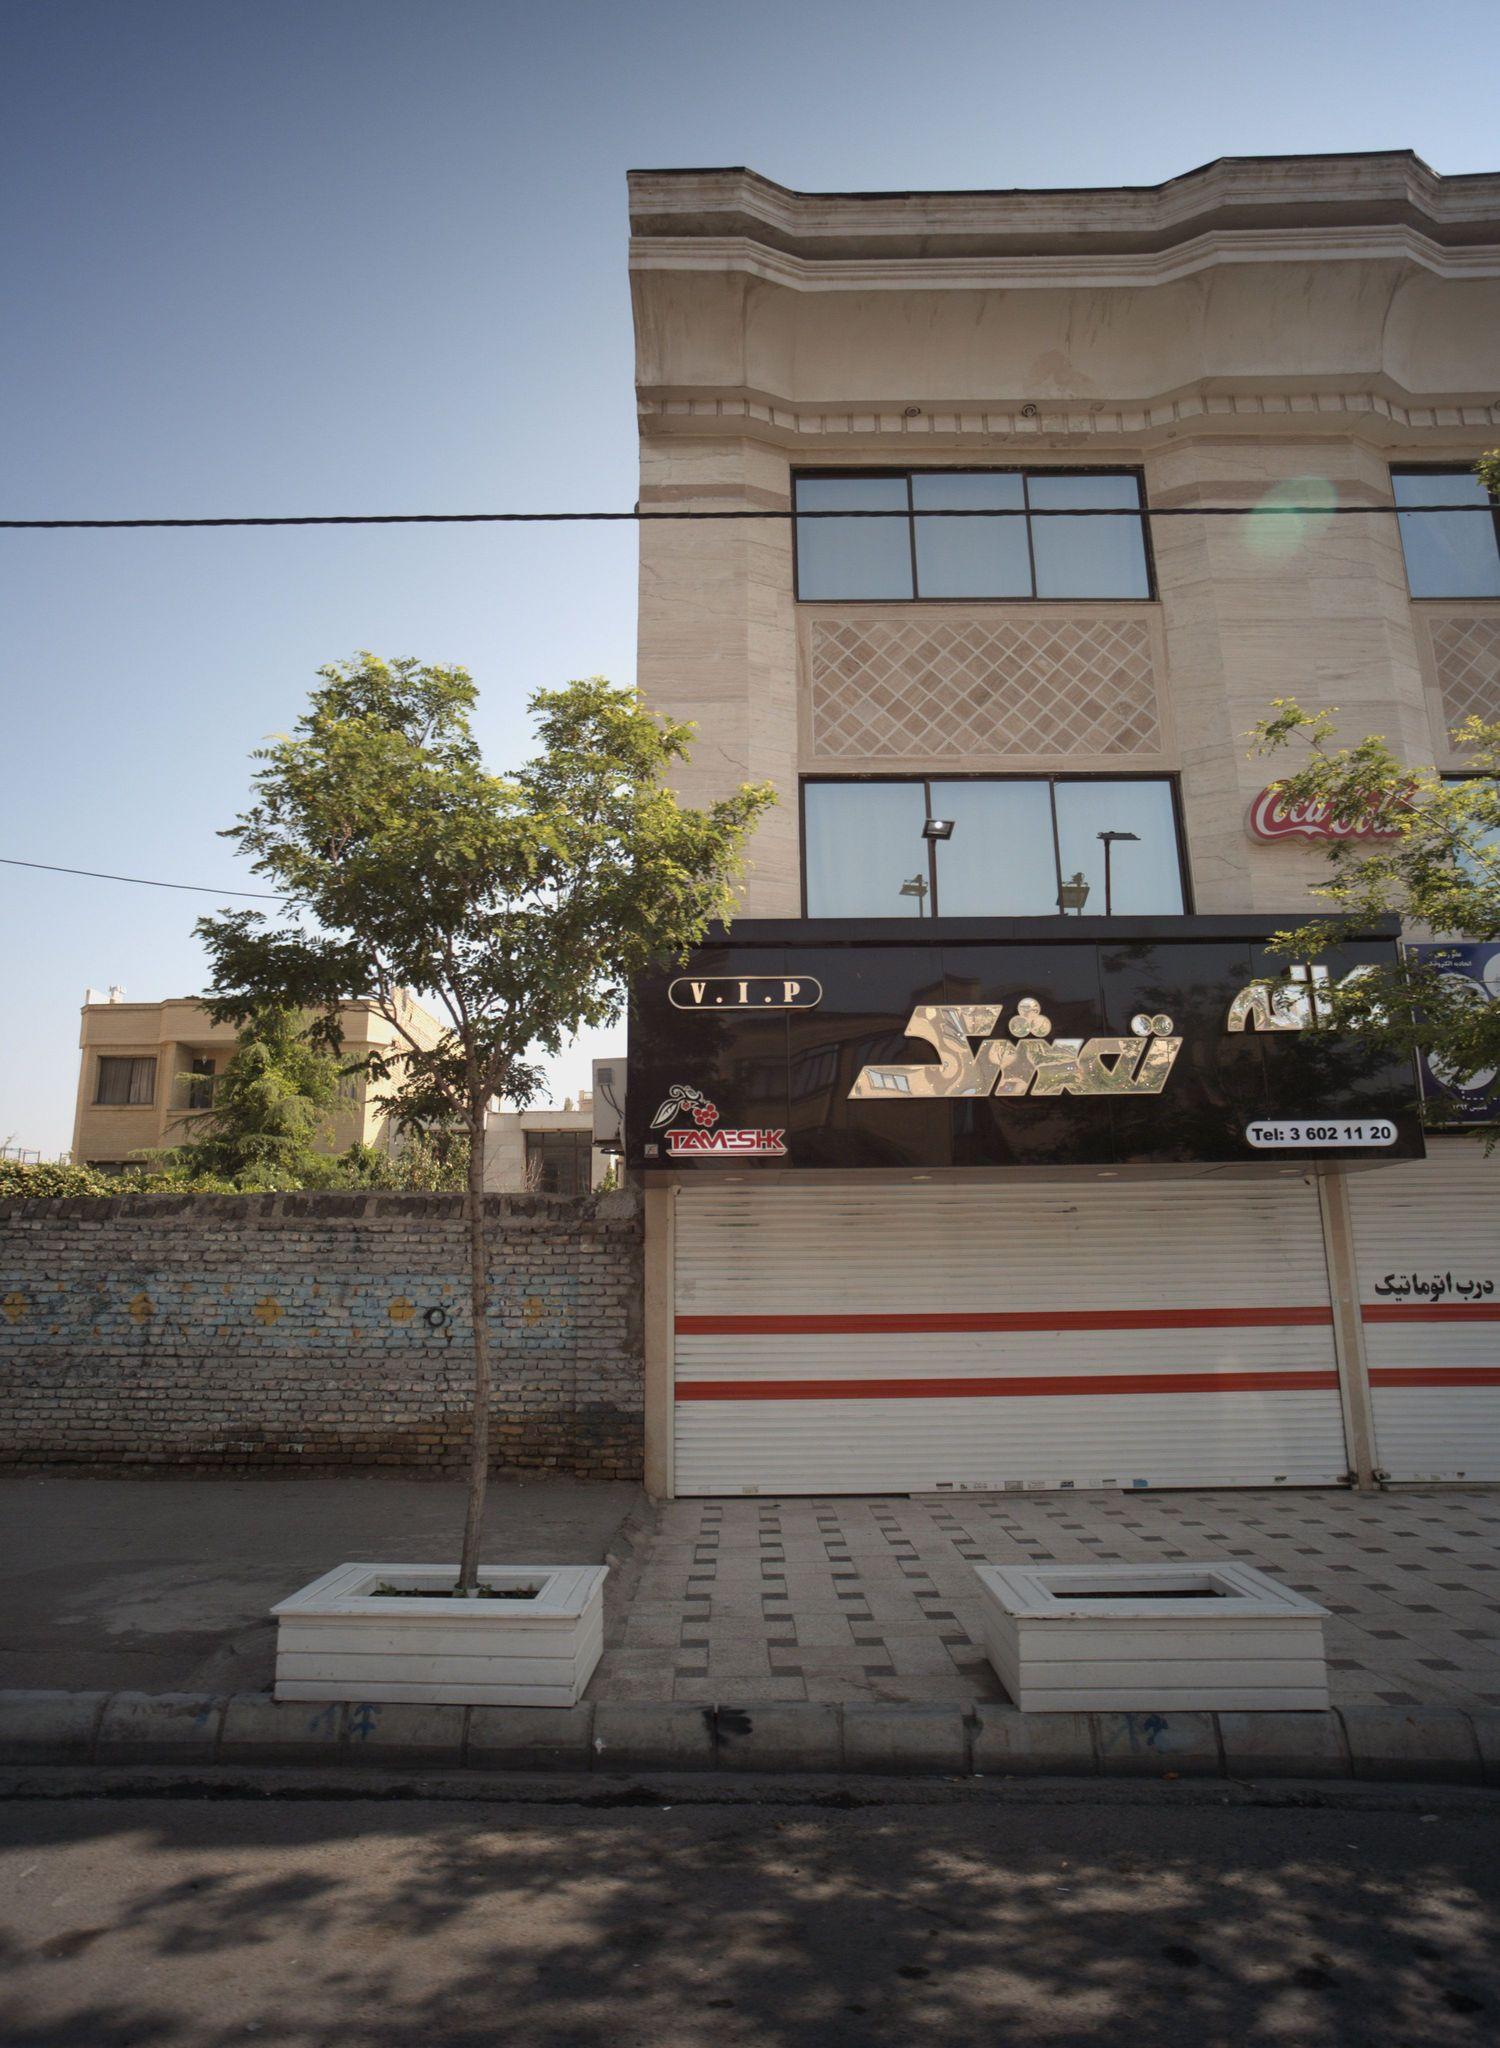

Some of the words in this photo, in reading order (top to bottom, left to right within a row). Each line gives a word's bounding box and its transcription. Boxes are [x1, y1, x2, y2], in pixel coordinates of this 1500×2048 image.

[848, 997, 1183, 1099] تمشک
[665, 1129, 786, 1150] TAMESHK
[1252, 1128, 1285, 1141] Tel:
[1290, 1127, 1301, 1141] 3
[1306, 1127, 1338, 1141] 602
[1344, 1126, 1363, 1140] 11
[1370, 1126, 1391, 1140] 20
[1375, 1272, 1452, 1302] اتوماتیک
[1456, 1278, 1495, 1300] درب
